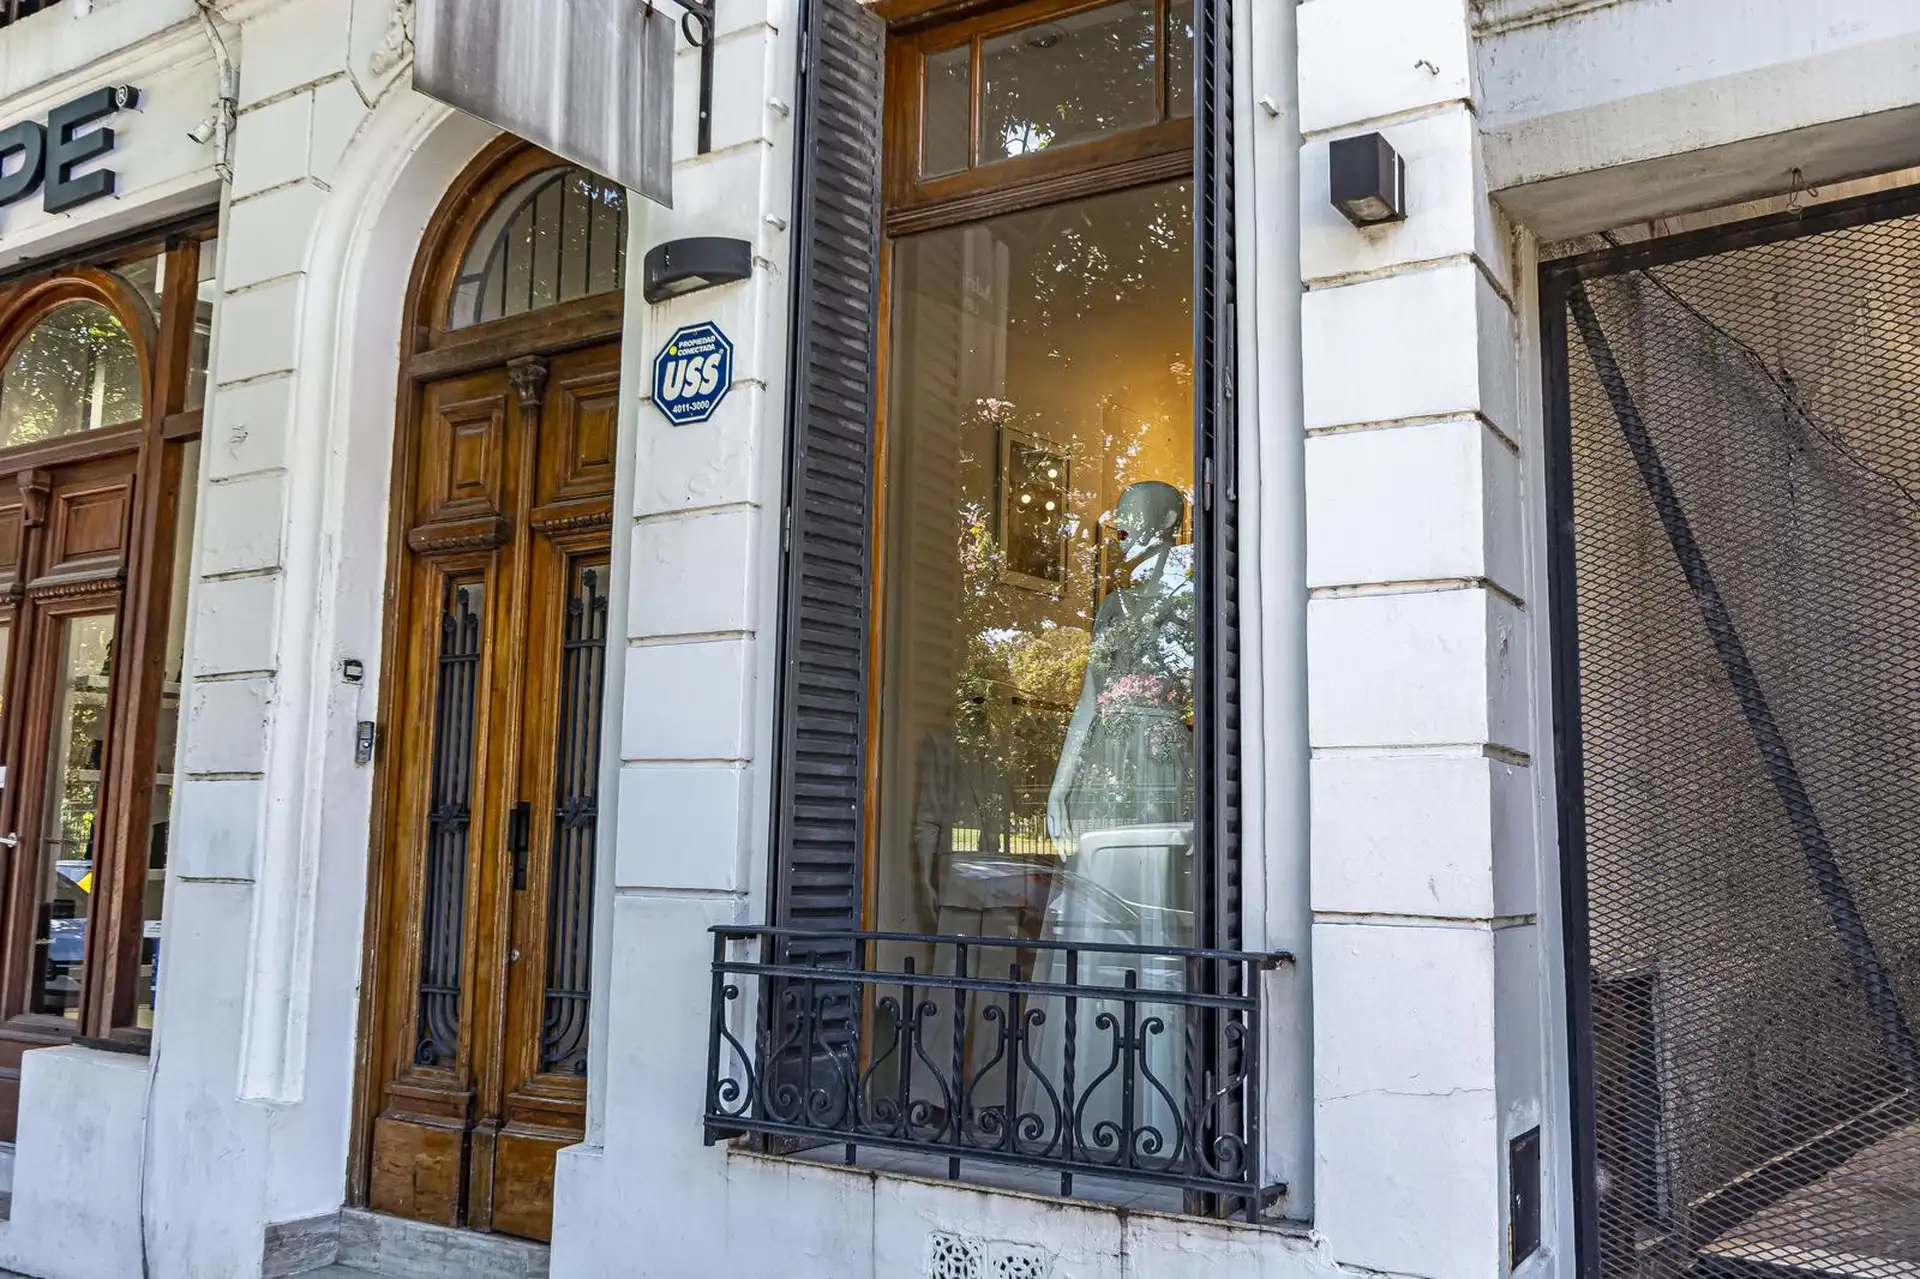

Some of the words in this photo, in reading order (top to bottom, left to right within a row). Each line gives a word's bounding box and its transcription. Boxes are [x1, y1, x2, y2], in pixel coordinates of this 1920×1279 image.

[679, 336, 716, 348] PROPIEDAD
[678, 344, 716, 356] CONECTADA
[663, 353, 721, 401] USS
[673, 400, 710, 413] 4011-3000
